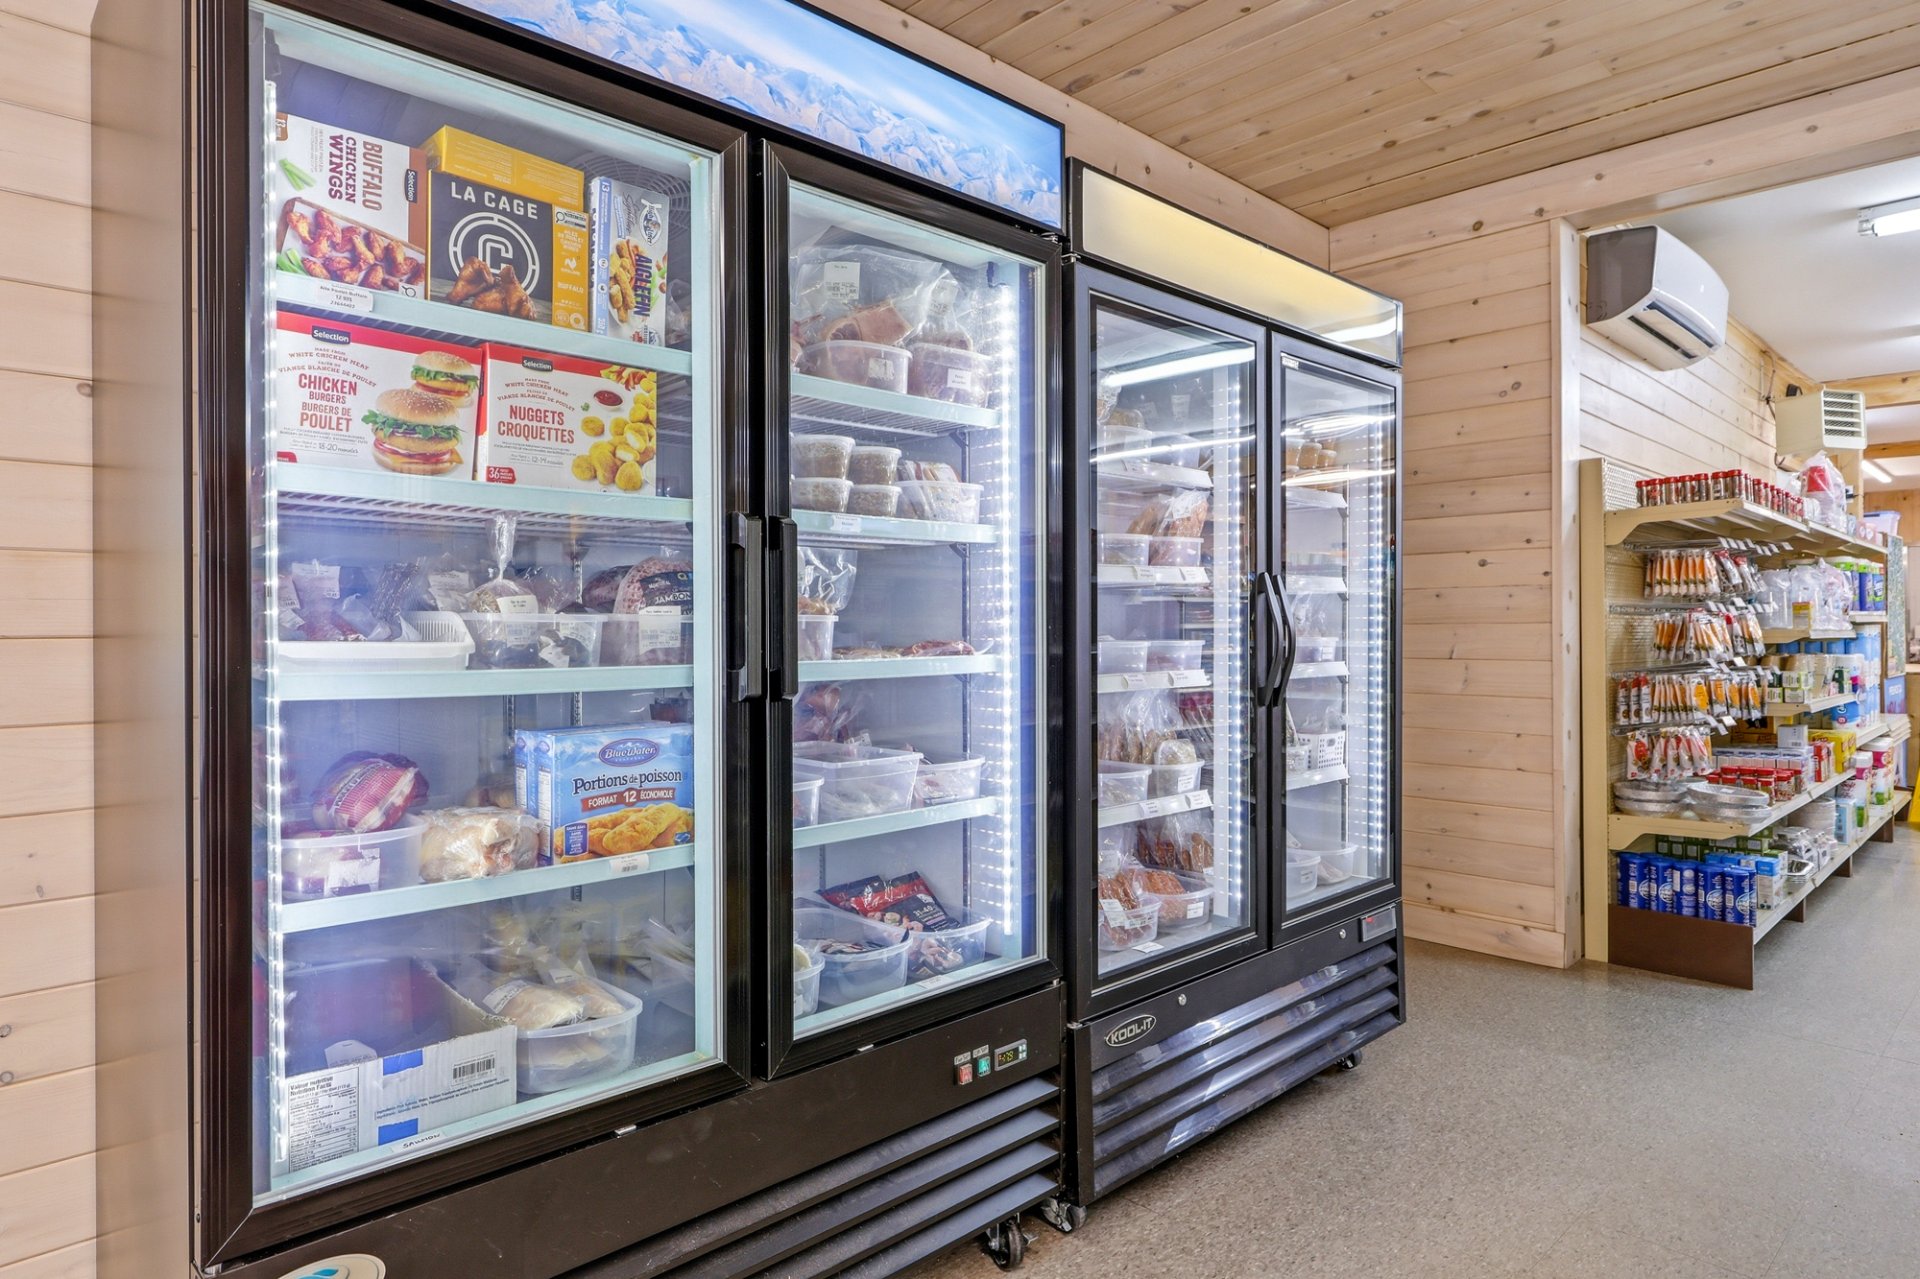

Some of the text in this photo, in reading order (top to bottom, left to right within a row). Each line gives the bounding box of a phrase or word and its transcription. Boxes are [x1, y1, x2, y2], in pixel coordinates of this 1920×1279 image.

[328, 134, 343, 200] WINGS
[345, 136, 357, 204] CHICKEN
[362, 140, 383, 211] BUFFALO
[407, 170, 416, 201] Selection
[451, 181, 476, 203] LA
[484, 191, 538, 220] CAGE
[633, 254, 653, 317] AIGLEFIN
[313, 329, 349, 343] Selection
[316, 352, 348, 362] CHICKEN
[350, 359, 369, 370] MEAT
[523, 360, 552, 371] Selection
[278, 365, 306, 373] VIANDE
[308, 365, 340, 374] BLANCHE
[352, 373, 377, 388] POULET
[298, 373, 358, 396] CHICKEN
[309, 391, 346, 405] BURGERS
[526, 382, 552, 390] CHICKEN
[553, 387, 569, 397] MEAT
[301, 402, 352, 417] BURGERS DE
[509, 404, 565, 426] NUGGETS
[555, 400, 575, 412] POULET
[300, 412, 352, 433] POULET
[497, 420, 575, 444] CROQUETTES
[654, 591, 692, 604] JAMBON
[572, 768, 682, 795] Portions de poisson
[588, 788, 674, 808] FORMAT 12 ÉCONOMIQUE
[290, 1076, 333, 1091] Valeur nutritive
[290, 1082, 332, 1096] Nutrition Facts
